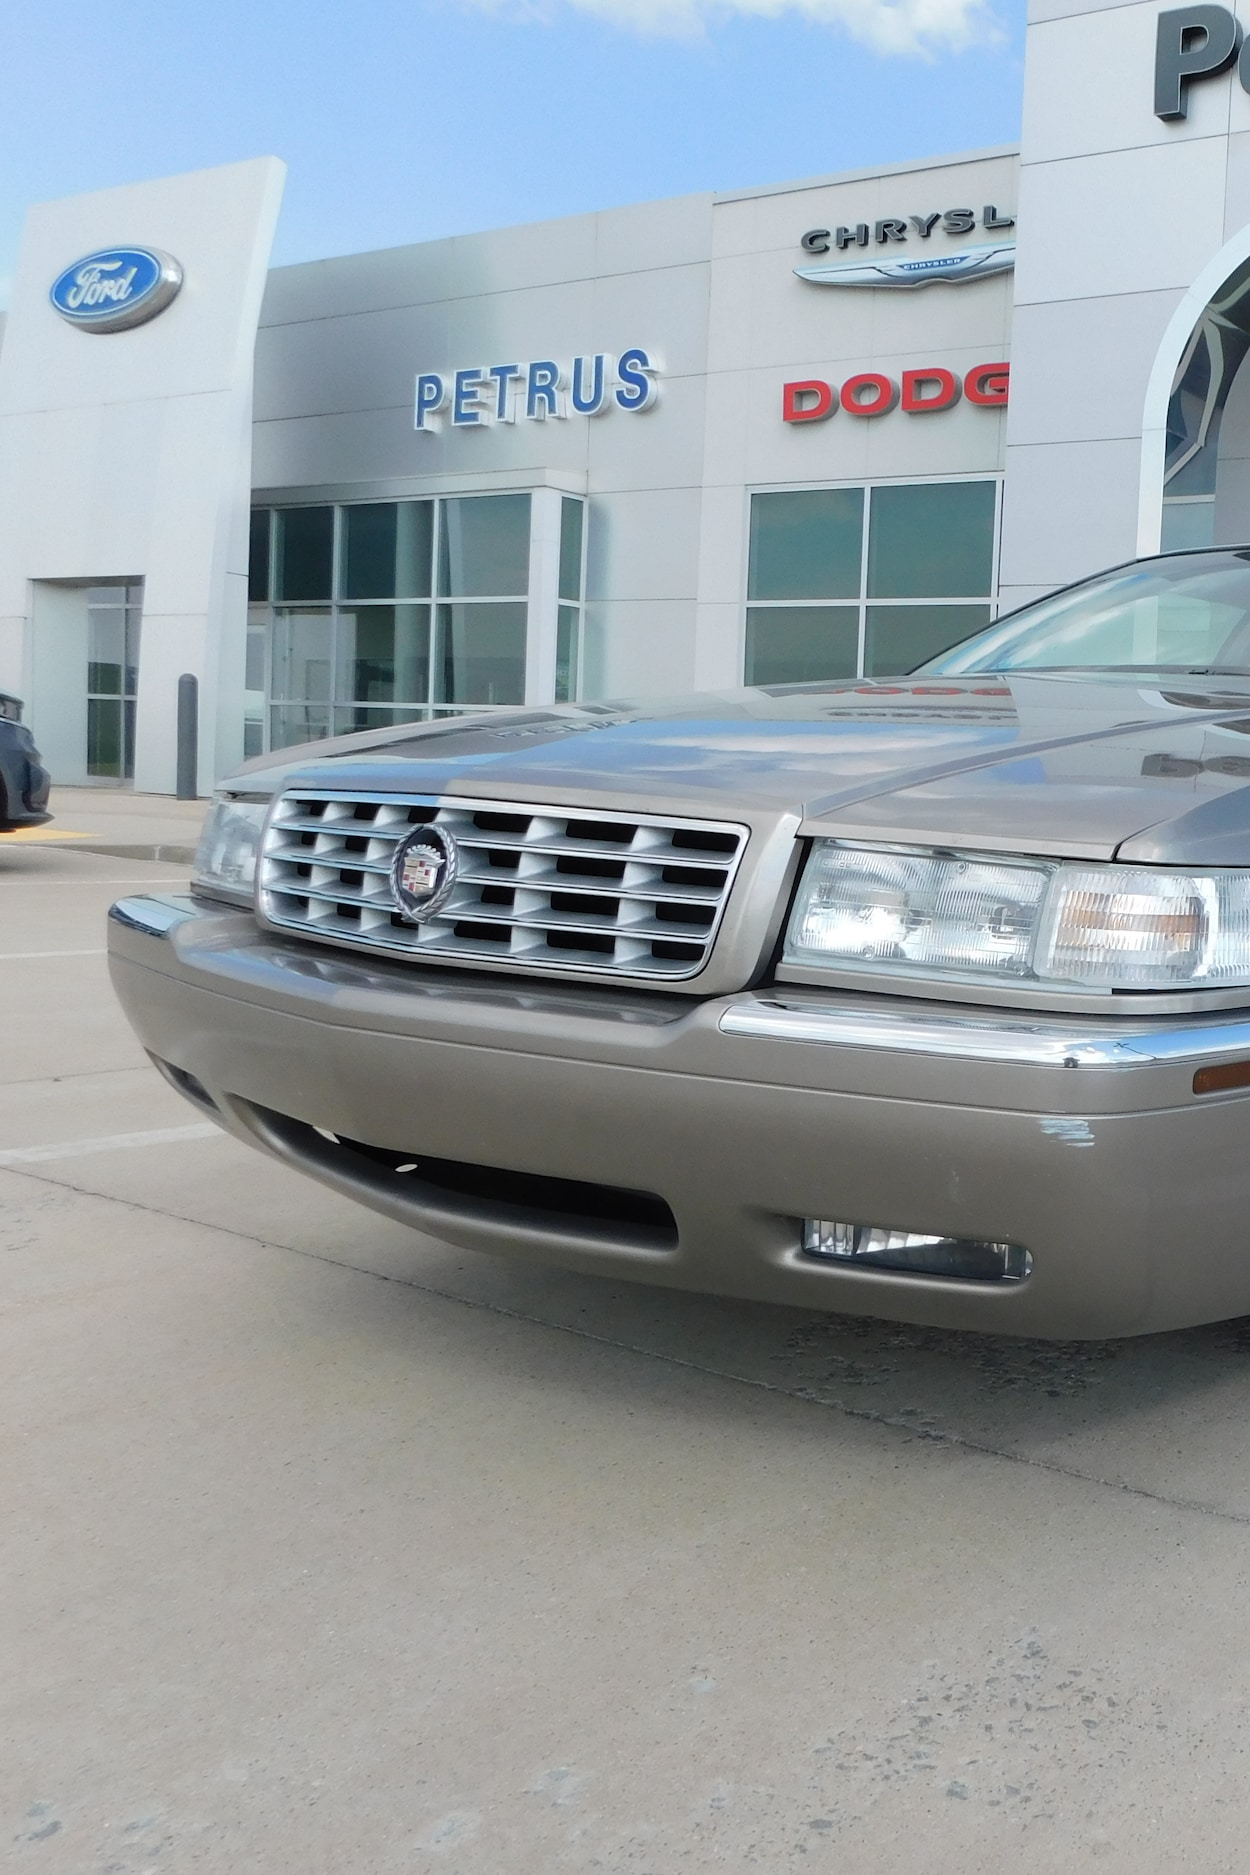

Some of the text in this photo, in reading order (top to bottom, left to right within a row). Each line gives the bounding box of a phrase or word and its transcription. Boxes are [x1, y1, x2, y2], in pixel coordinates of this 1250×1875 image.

[800, 204, 1015, 254] CHRYSL
[67, 260, 138, 309] Ford
[903, 257, 961, 271] CHRYSLER
[412, 347, 664, 432] PETRUS
[783, 361, 1010, 424] DODG
